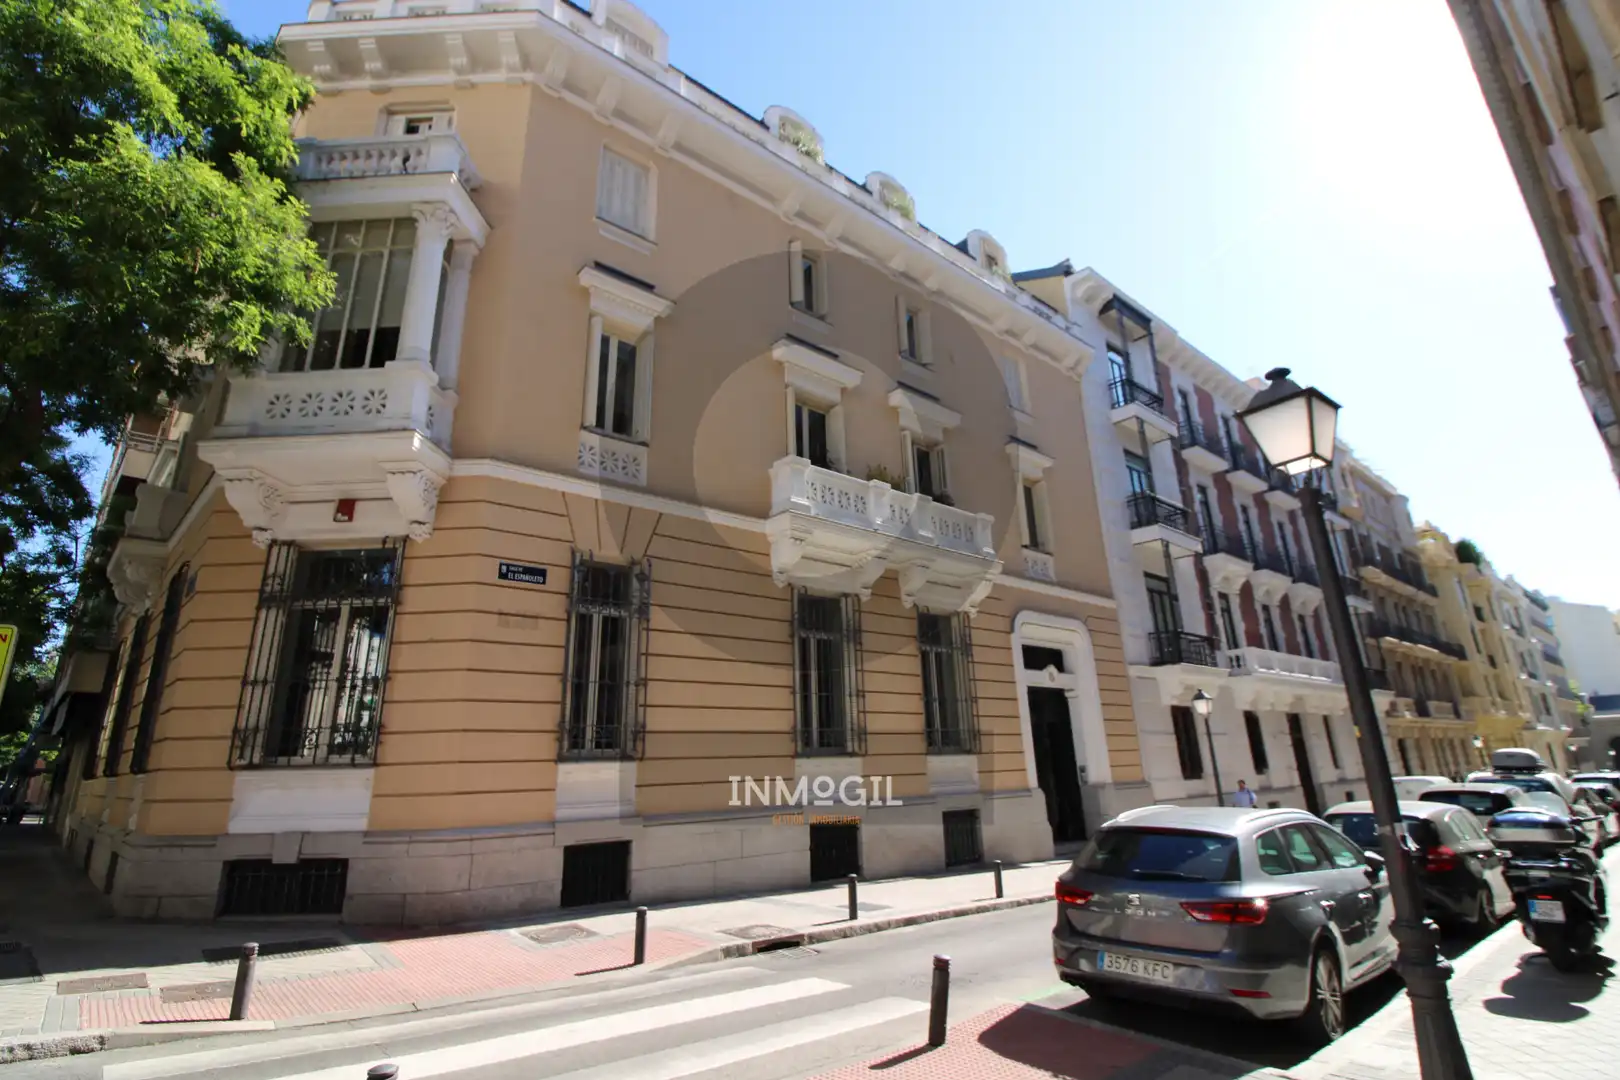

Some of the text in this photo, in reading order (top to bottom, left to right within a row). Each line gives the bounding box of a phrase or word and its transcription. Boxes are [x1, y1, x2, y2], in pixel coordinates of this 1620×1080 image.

[515, 573, 543, 583] ESPAÑOLETO
[1107, 955, 1170, 979] 3576 KFC
